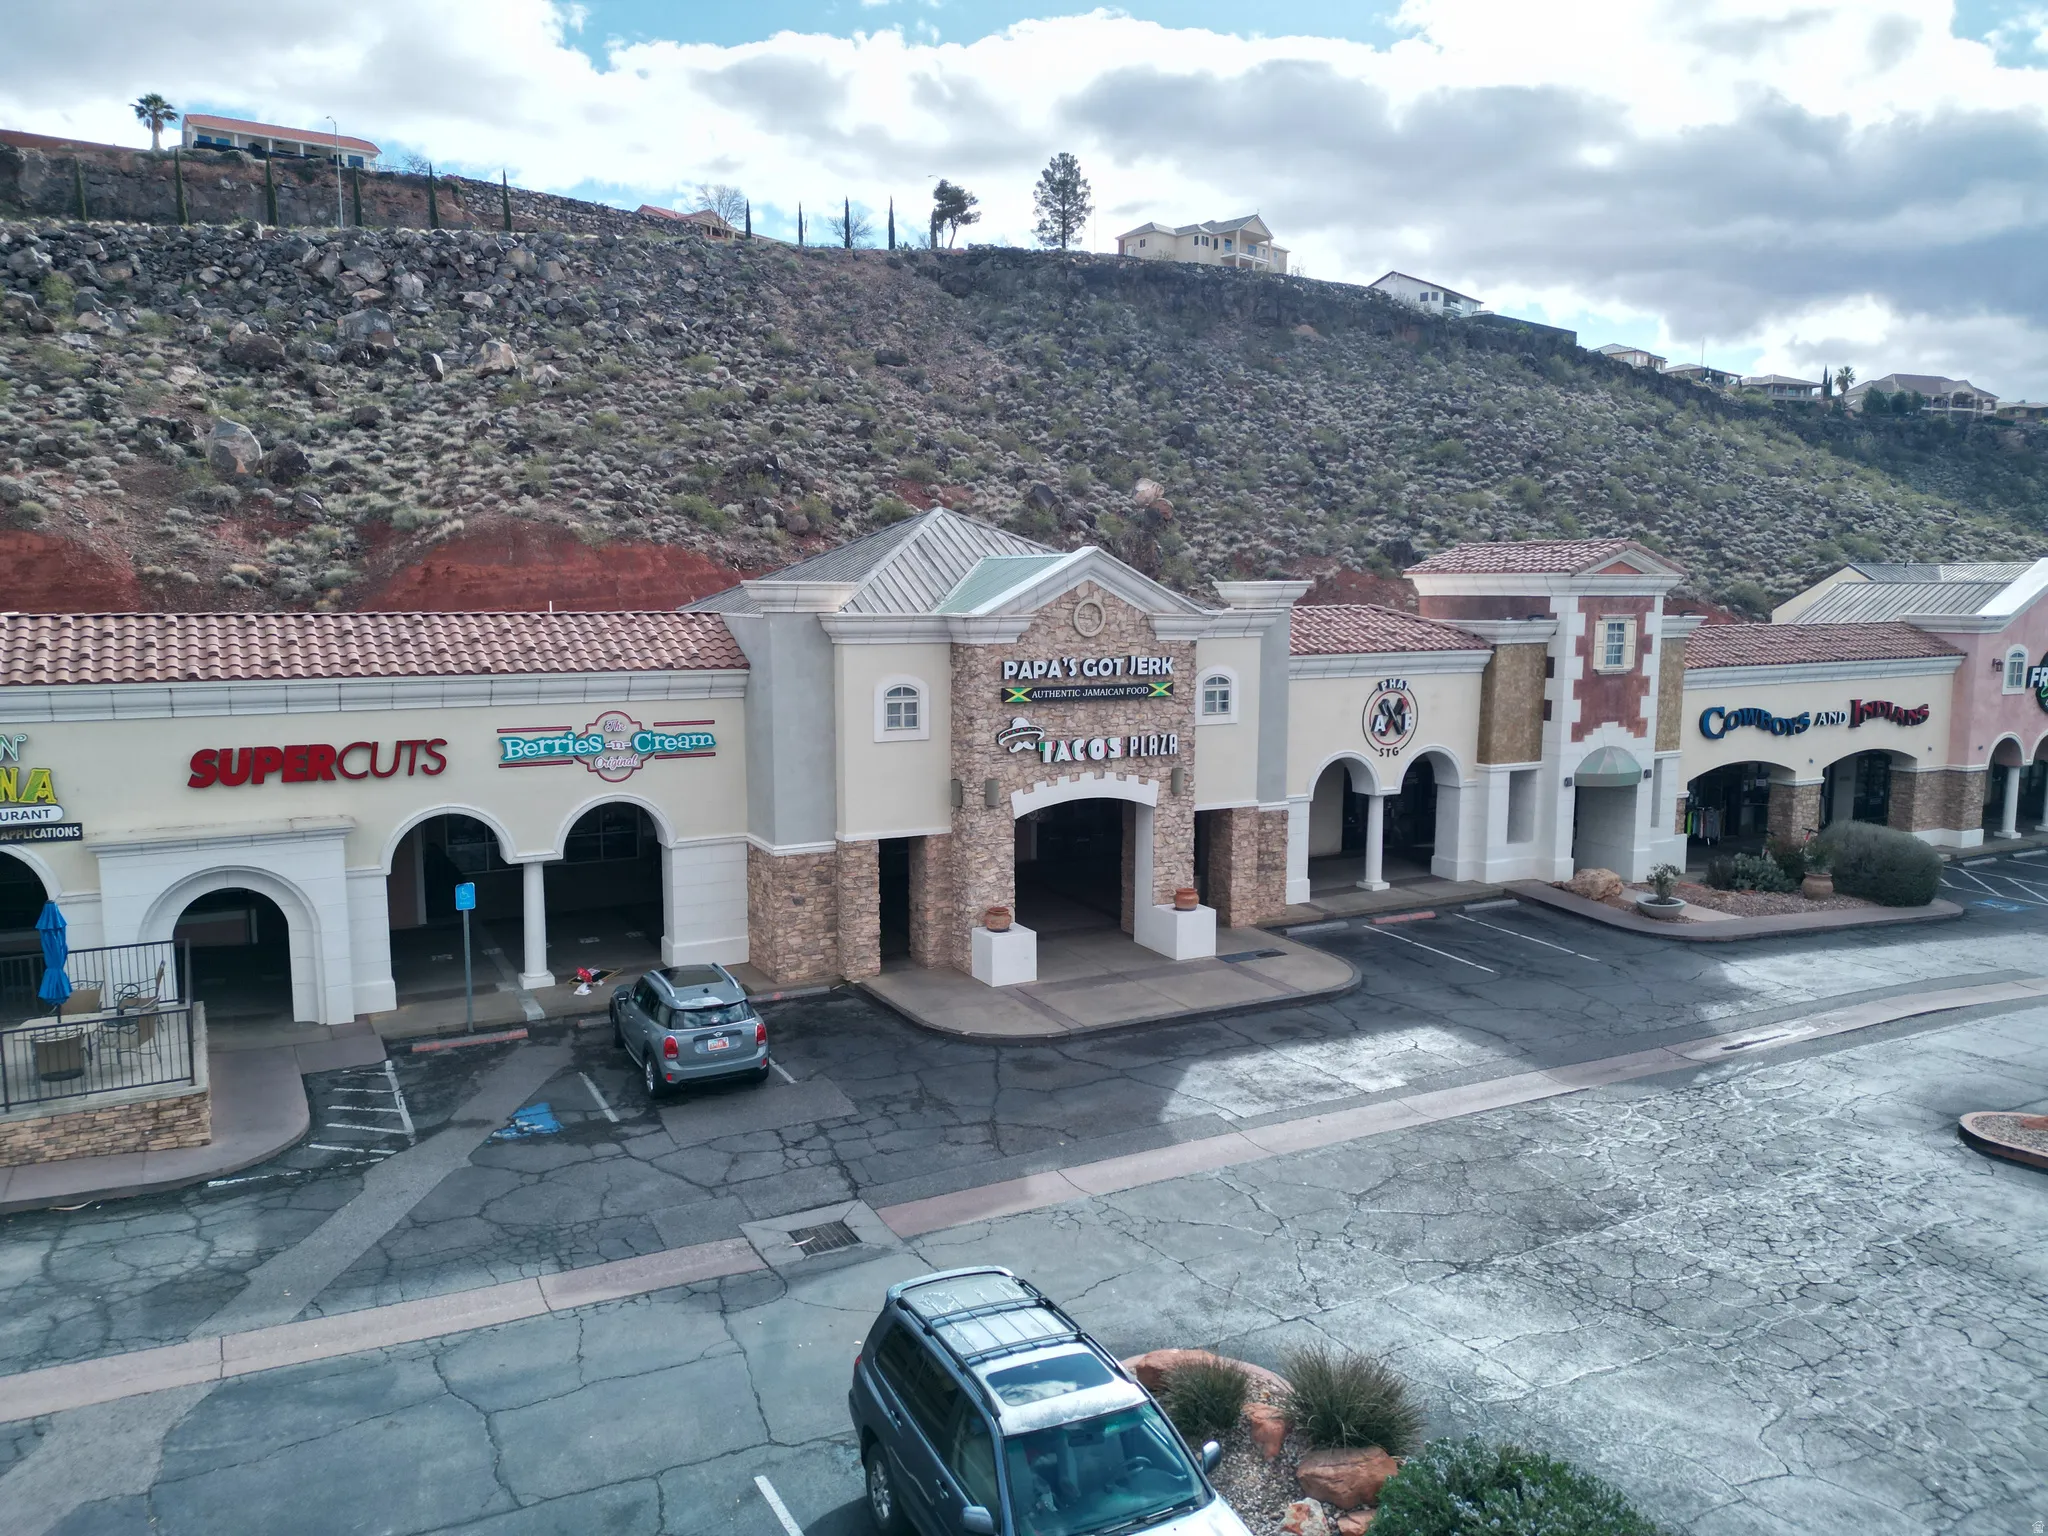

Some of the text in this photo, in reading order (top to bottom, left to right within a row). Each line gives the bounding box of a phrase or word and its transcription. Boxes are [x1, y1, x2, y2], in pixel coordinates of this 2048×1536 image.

[1003, 656, 1174, 680] PAPA'S GOT JERK
[1031, 686, 1149, 699] AUTHENTIC JAMAICAN FOOD
[604, 720, 627, 732] The
[1815, 711, 1848, 726] AND
[501, 731, 604, 761] Berries
[632, 731, 715, 754] Cream
[1038, 733, 1178, 764] TACOS PLAZA
[1379, 747, 1400, 758] STG
[187, 738, 448, 789] SUPERCUTS
[594, 754, 639, 769] Original
